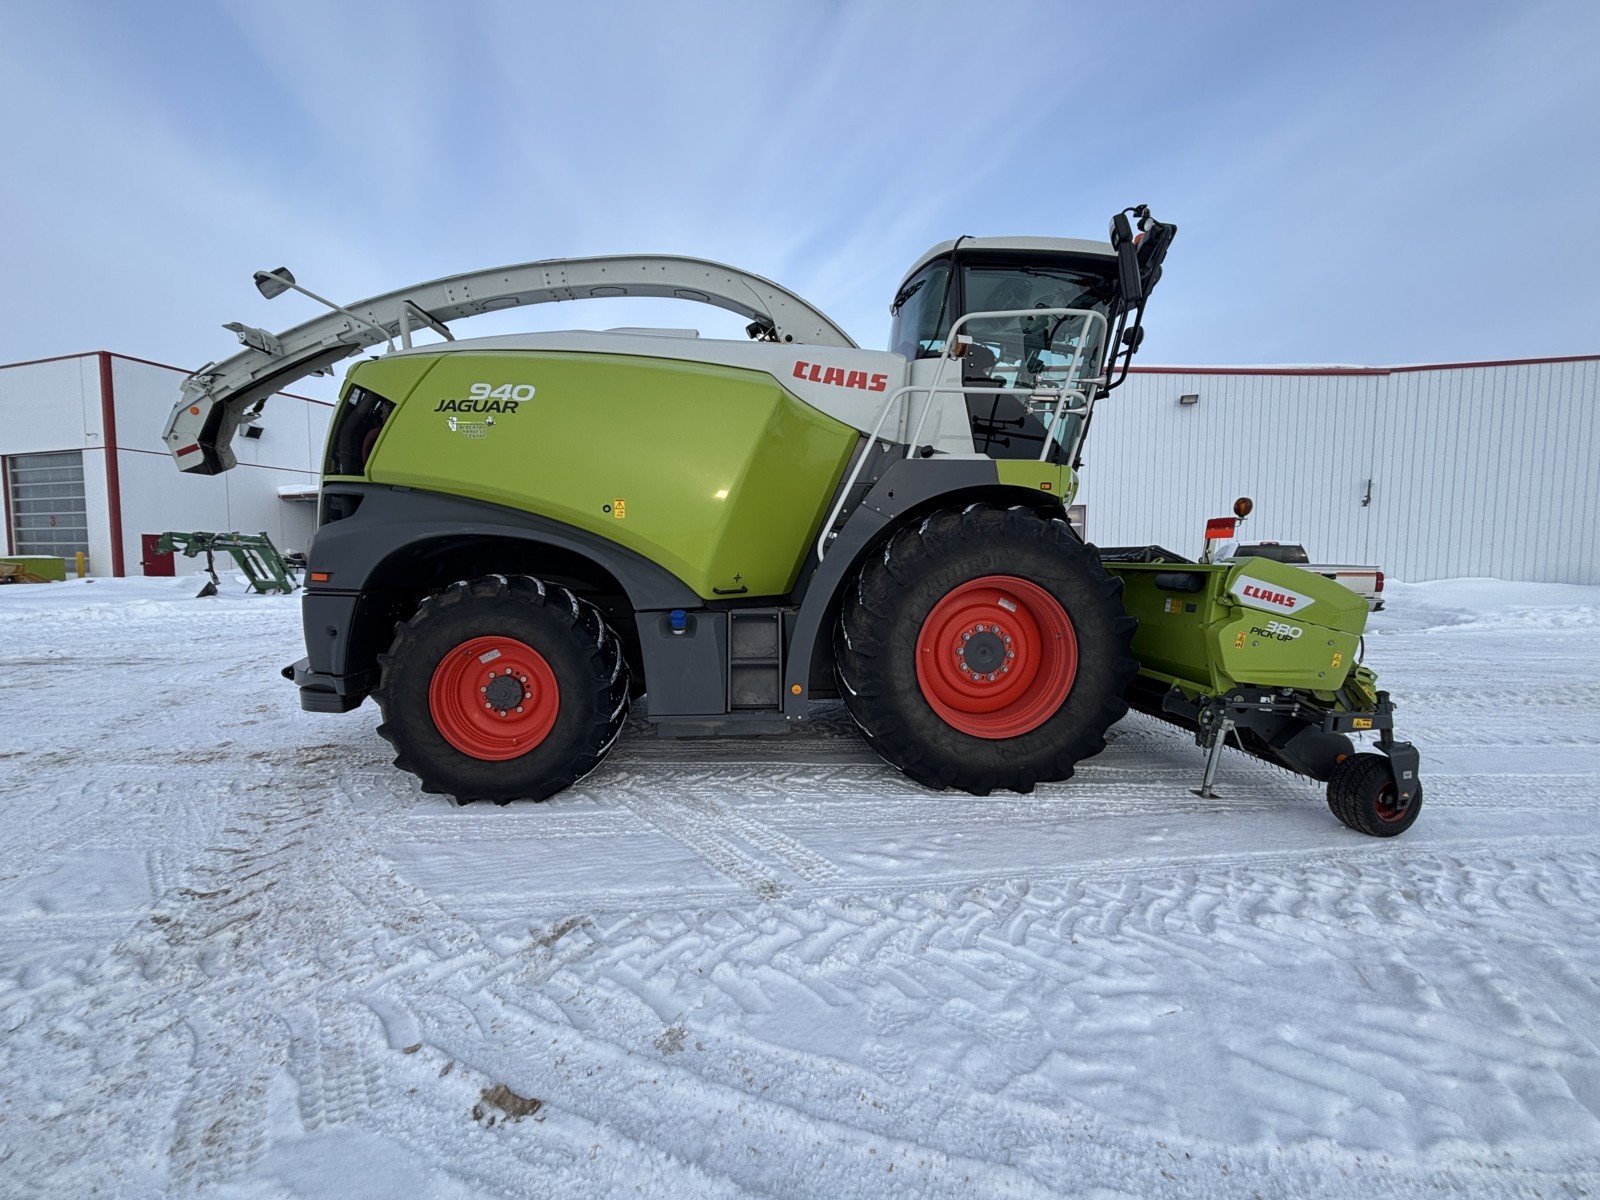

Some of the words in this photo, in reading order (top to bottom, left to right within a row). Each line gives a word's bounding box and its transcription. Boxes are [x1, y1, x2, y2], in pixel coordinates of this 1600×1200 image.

[792, 360, 888, 392] CLAAS
[469, 382, 536, 402] 940
[433, 399, 519, 413] JAGUAR
[1243, 585, 1297, 608] CLAAS
[1250, 626, 1277, 639] PICK
[1276, 633, 1294, 642] UP
[1265, 620, 1303, 638] 380
